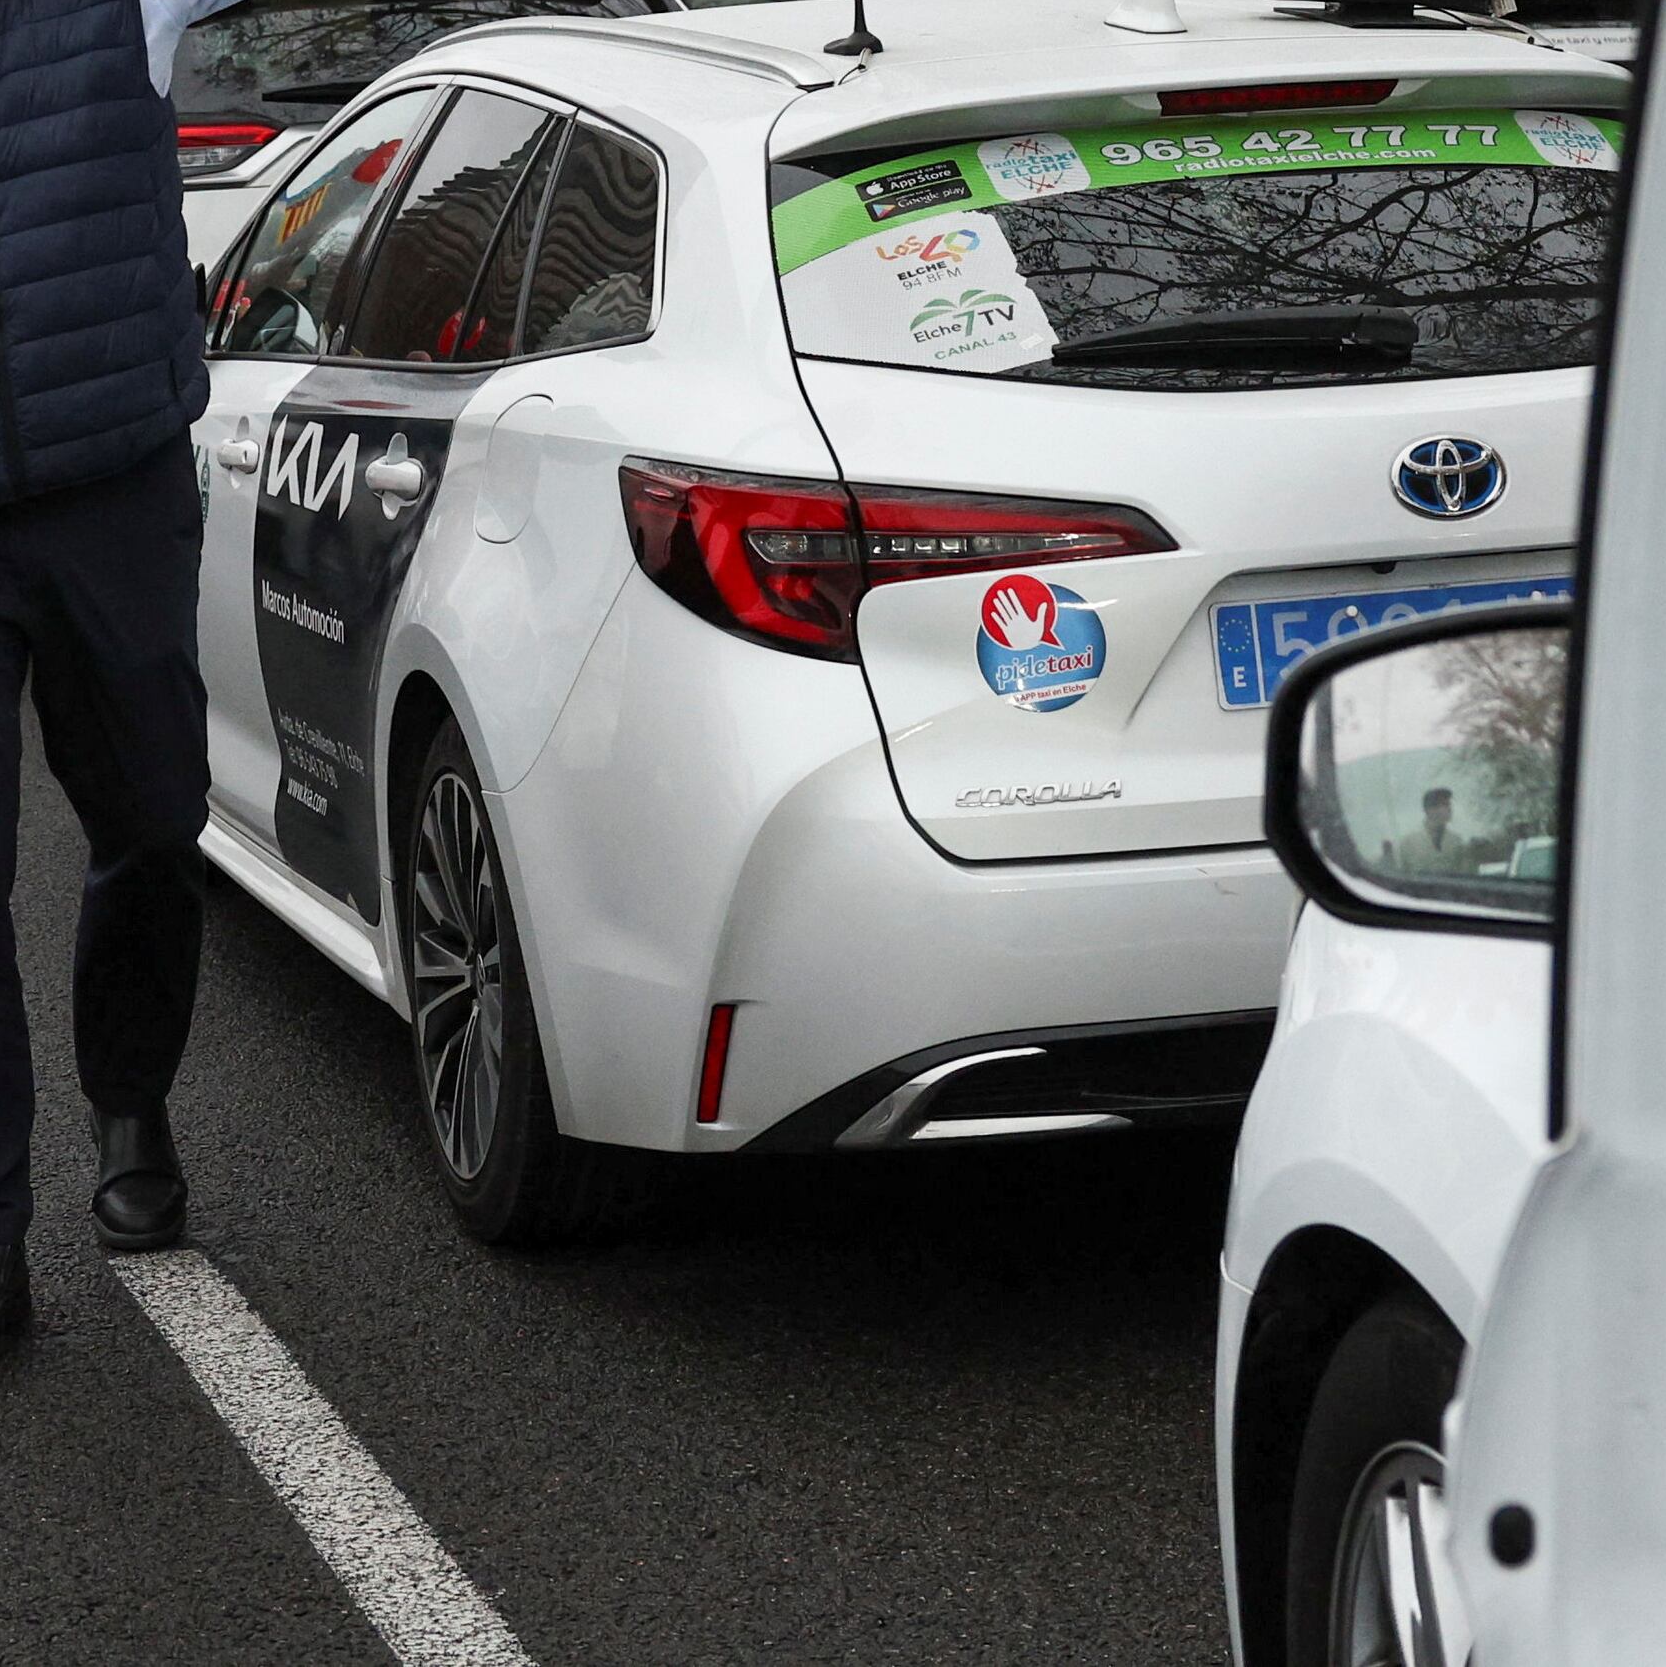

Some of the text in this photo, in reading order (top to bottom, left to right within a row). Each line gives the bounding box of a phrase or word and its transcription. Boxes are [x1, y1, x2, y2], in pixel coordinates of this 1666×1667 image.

[1100, 124, 1499, 166] 965 42 77 77
[1539, 137, 1606, 152] ELCHE
[984, 150, 1078, 171] radiotaxi
[1000, 160, 1075, 181] ELCHE
[1173, 146, 1437, 173] radiotaxielche.com
[890, 178, 917, 190] App
[917, 170, 952, 183] Store
[897, 192, 940, 208] Google
[942, 187, 966, 198] play
[896, 260, 948, 281] ELCHE
[913, 321, 962, 344] Elche
[934, 331, 1018, 361] CANAL 43
[261, 578, 345, 645] Marcos Automoción
[995, 645, 1094, 691] pidetaxi
[1233, 665, 1247, 689] E
[1020, 691, 1037, 703] APP
[1037, 690, 1052, 700] taxi
[1063, 683, 1088, 695] Elche
[955, 779, 1122, 808] COROLLA
